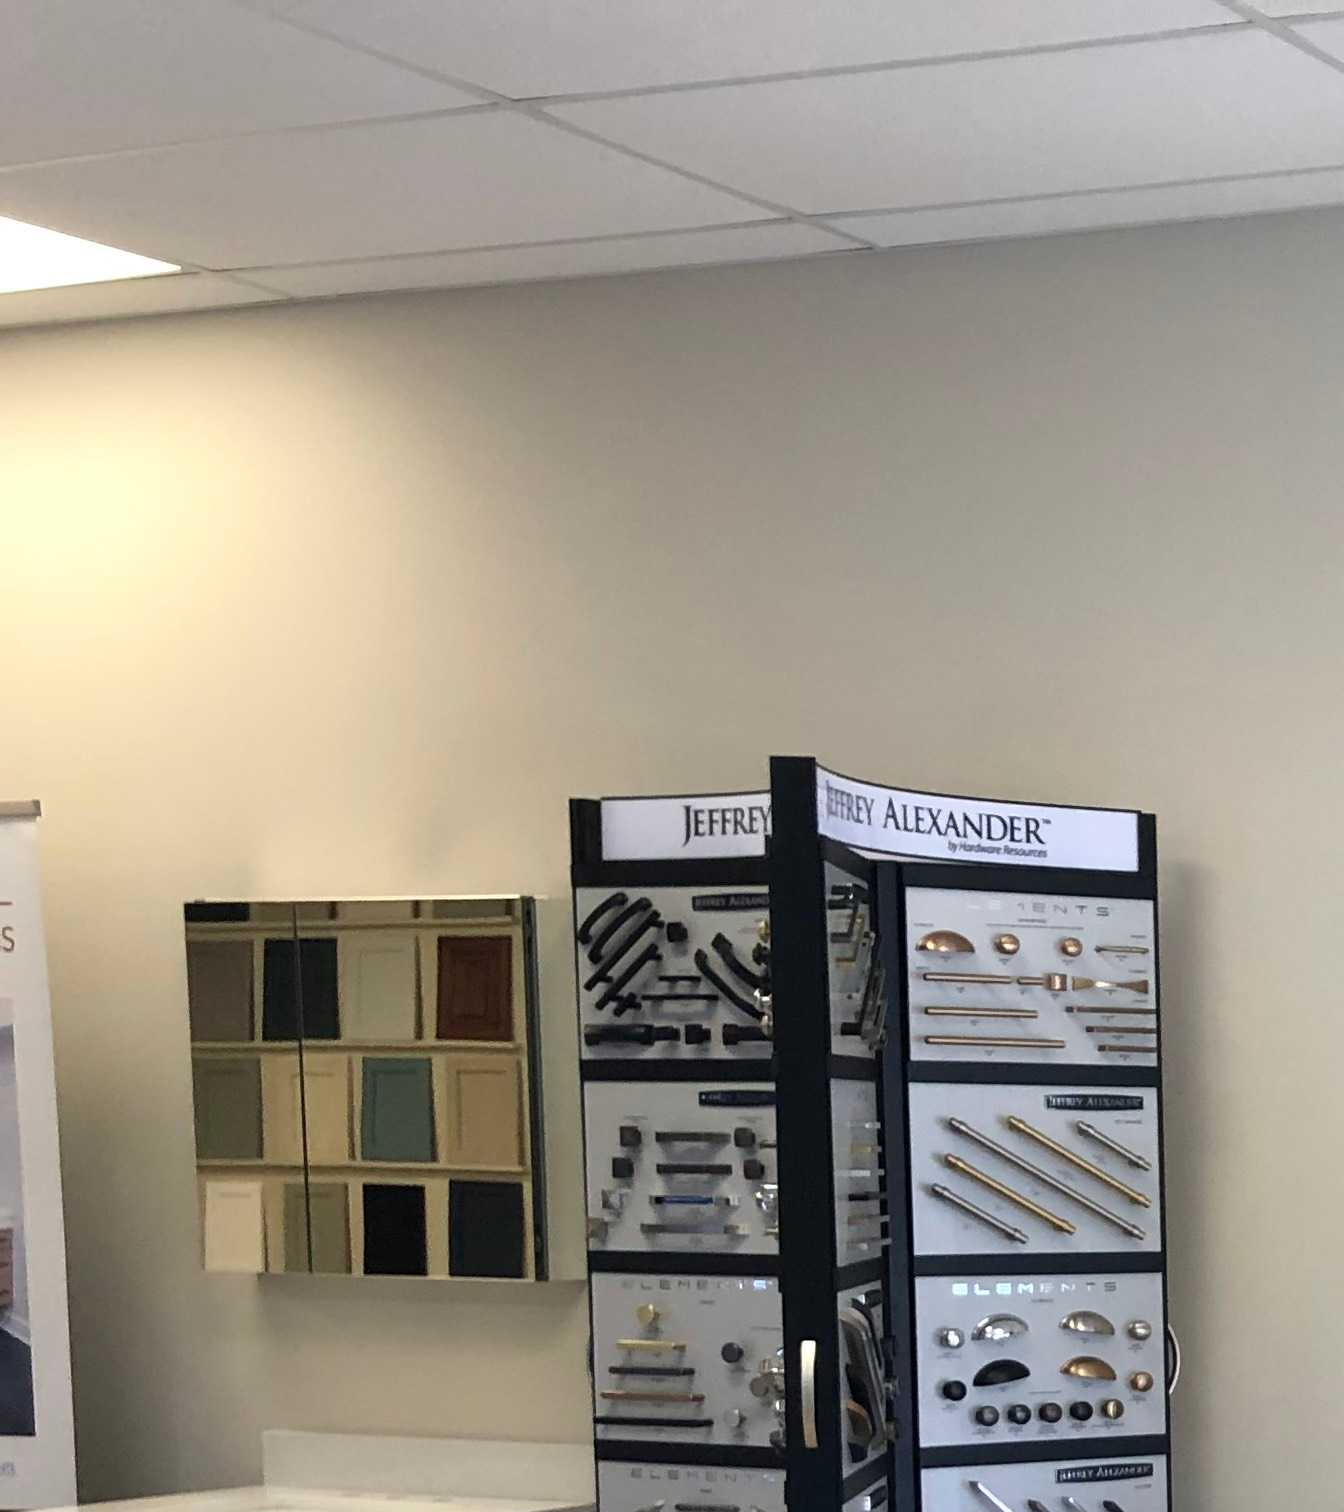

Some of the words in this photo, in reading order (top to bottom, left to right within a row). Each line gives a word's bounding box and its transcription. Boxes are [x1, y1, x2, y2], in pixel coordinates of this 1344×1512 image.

[682, 805, 771, 847] JEFFREY
[883, 797, 1044, 844] ALEXANDER
[952, 1282, 1117, 1295] ELEMENTS
